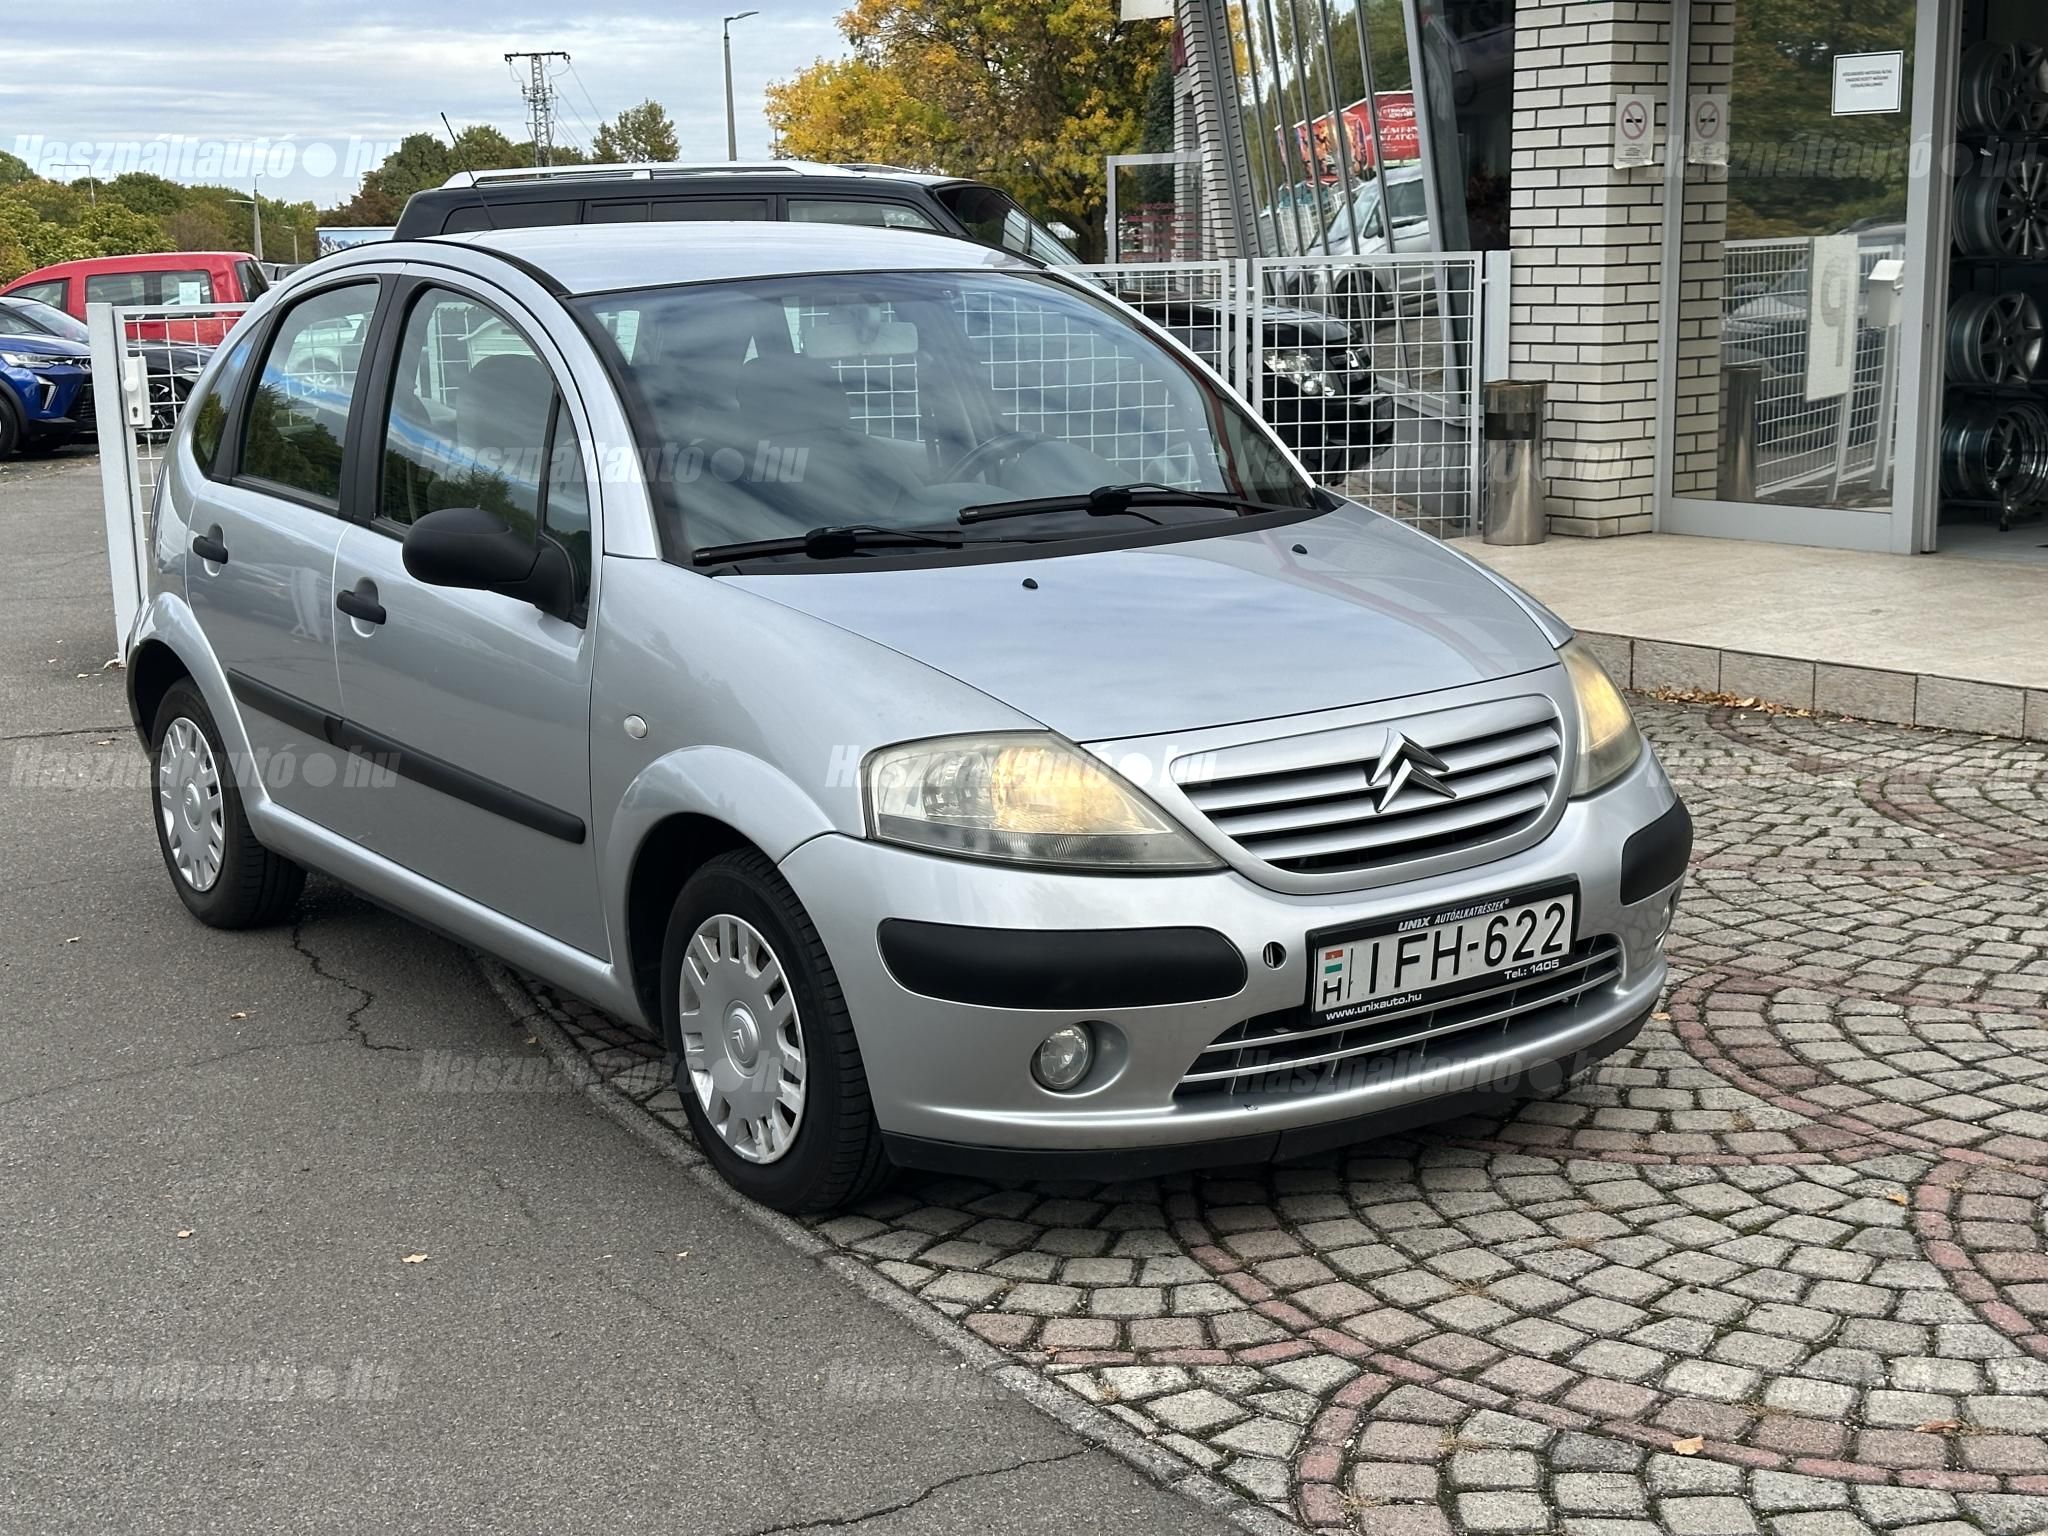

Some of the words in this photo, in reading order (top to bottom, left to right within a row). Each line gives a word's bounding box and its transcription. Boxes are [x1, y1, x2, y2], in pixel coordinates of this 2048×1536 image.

[1398, 916, 1431, 932] UNIX
[1369, 902, 1566, 994] IFH-622
[1504, 967, 1527, 980] Tel.:
[1530, 959, 1560, 974] 1405
[1326, 993, 1422, 1020] www.unixauto.hu
